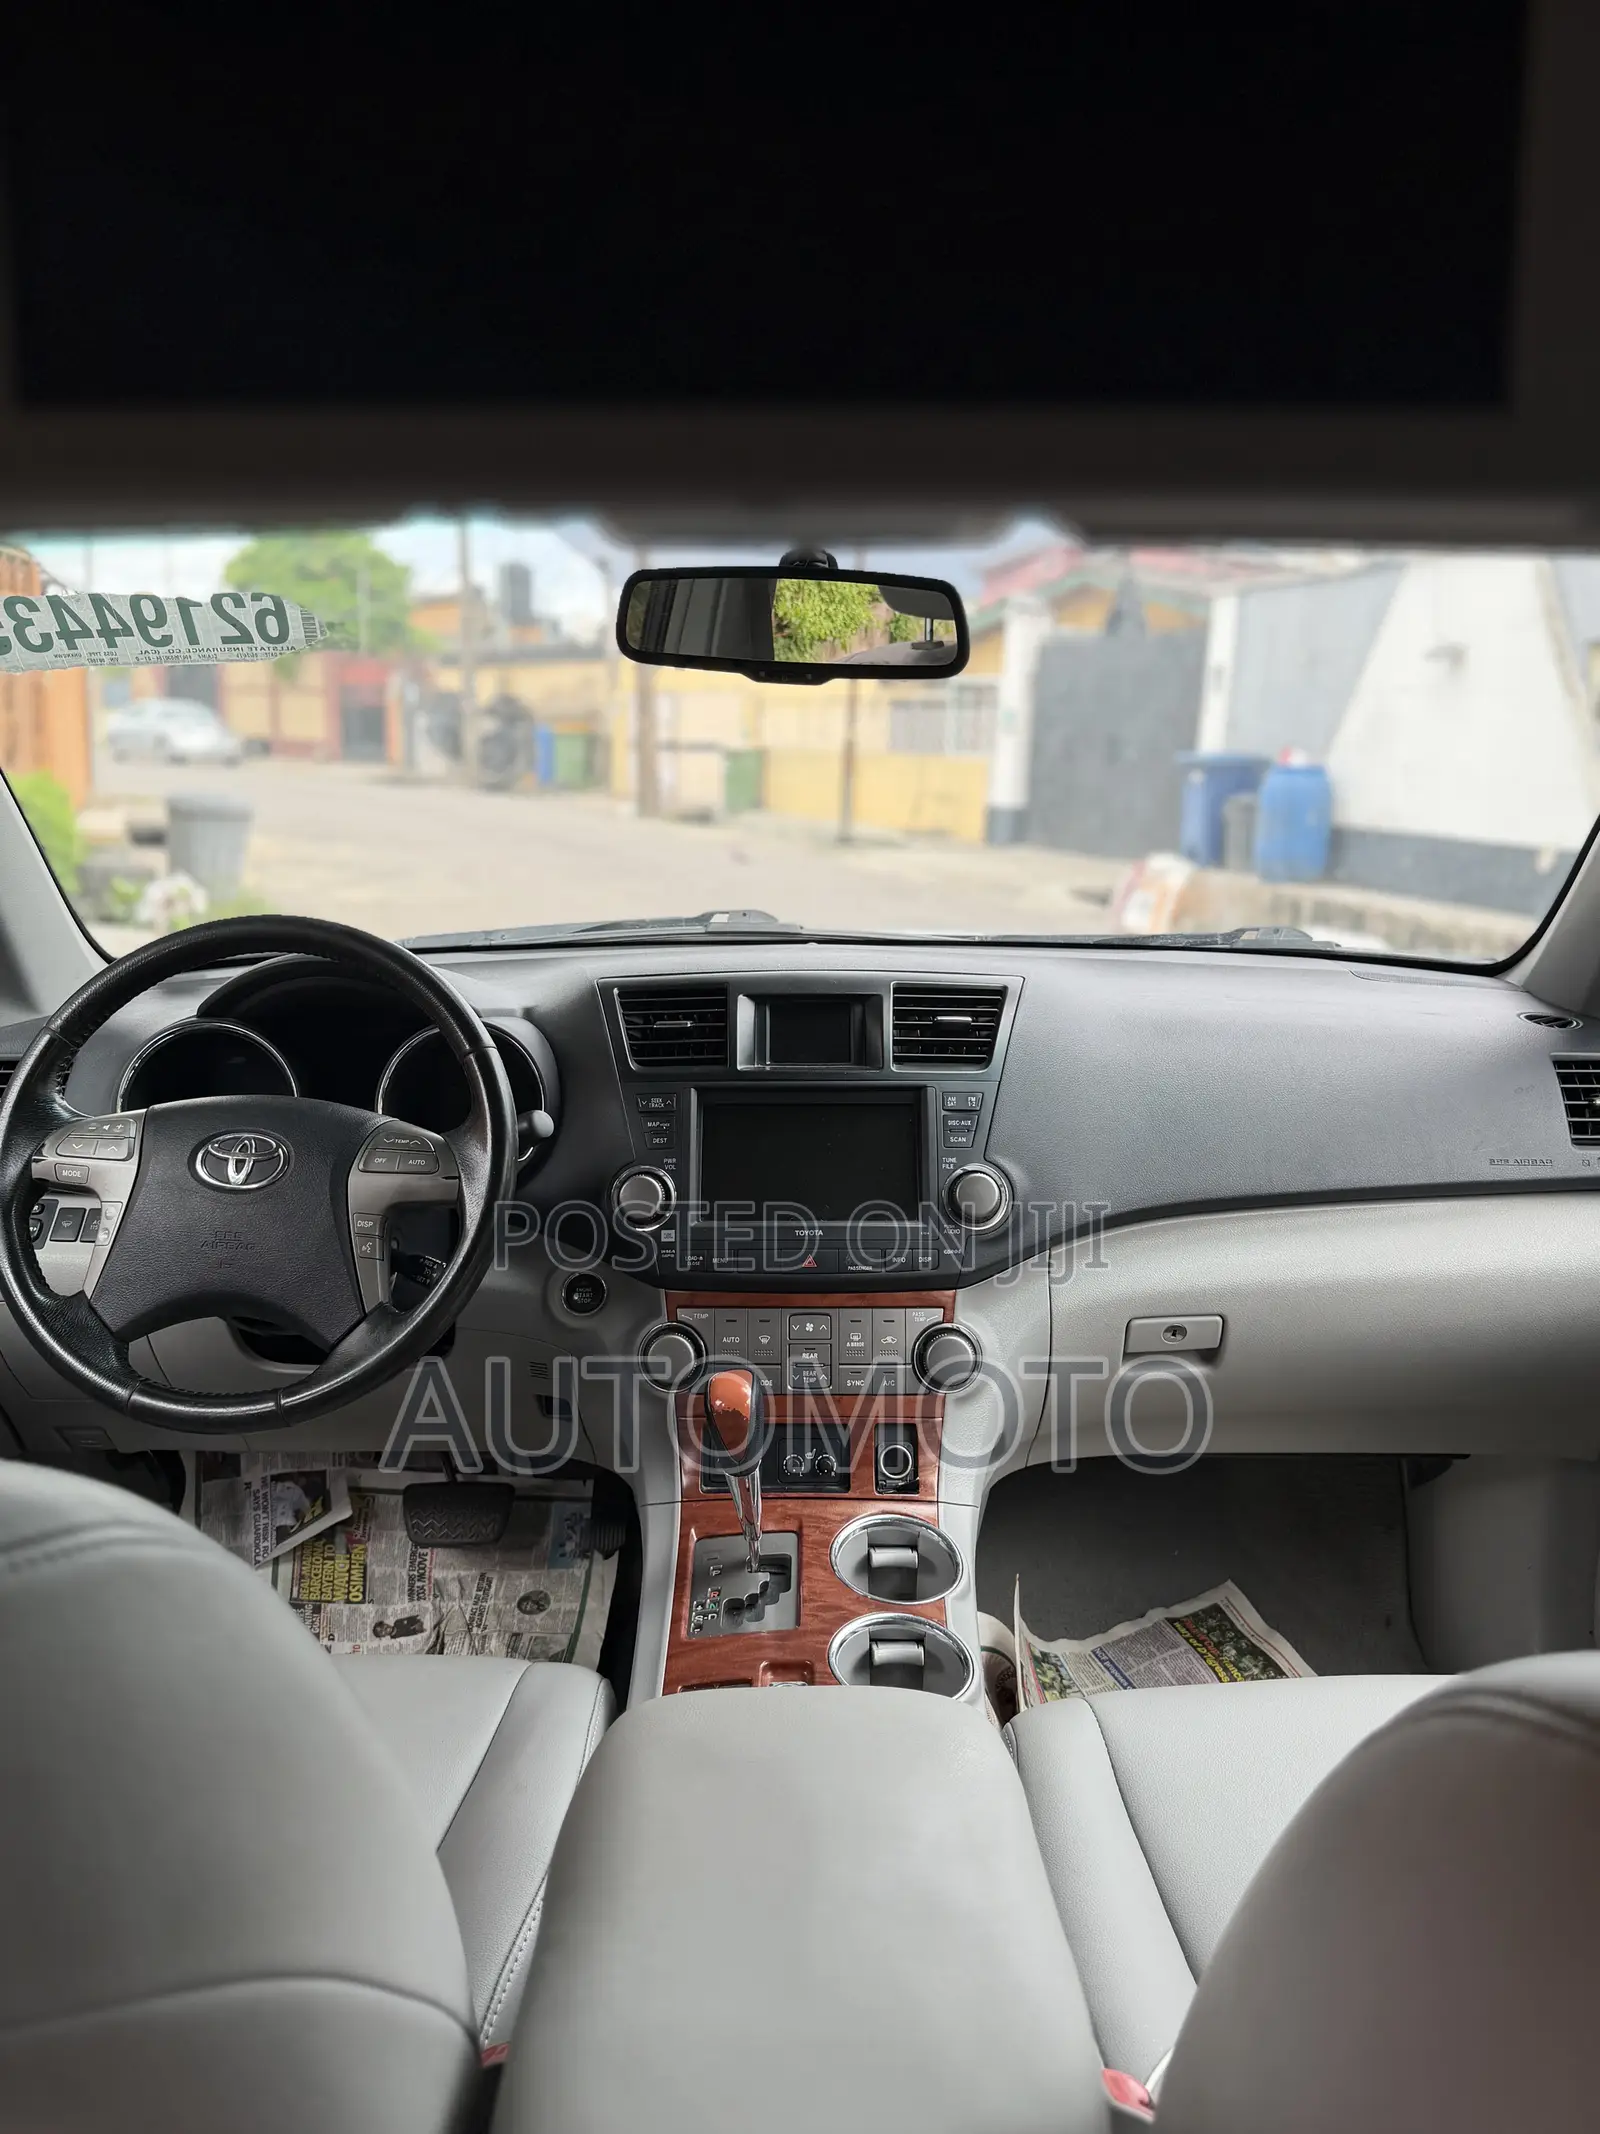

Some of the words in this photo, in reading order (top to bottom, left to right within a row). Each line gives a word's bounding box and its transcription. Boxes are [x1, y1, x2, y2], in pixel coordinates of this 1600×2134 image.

[62, 1169, 82, 1178] MODE
[357, 1220, 374, 1228] DISP
[253, 1489, 261, 1512] SAYS
[253, 1513, 261, 1566] GUARDIOLA
[324, 1544, 335, 1558] TO
[321, 1560, 335, 1601] BAYERN
[333, 1554, 350, 1602] WATCH
[349, 1543, 366, 1602] OSIMHEN
